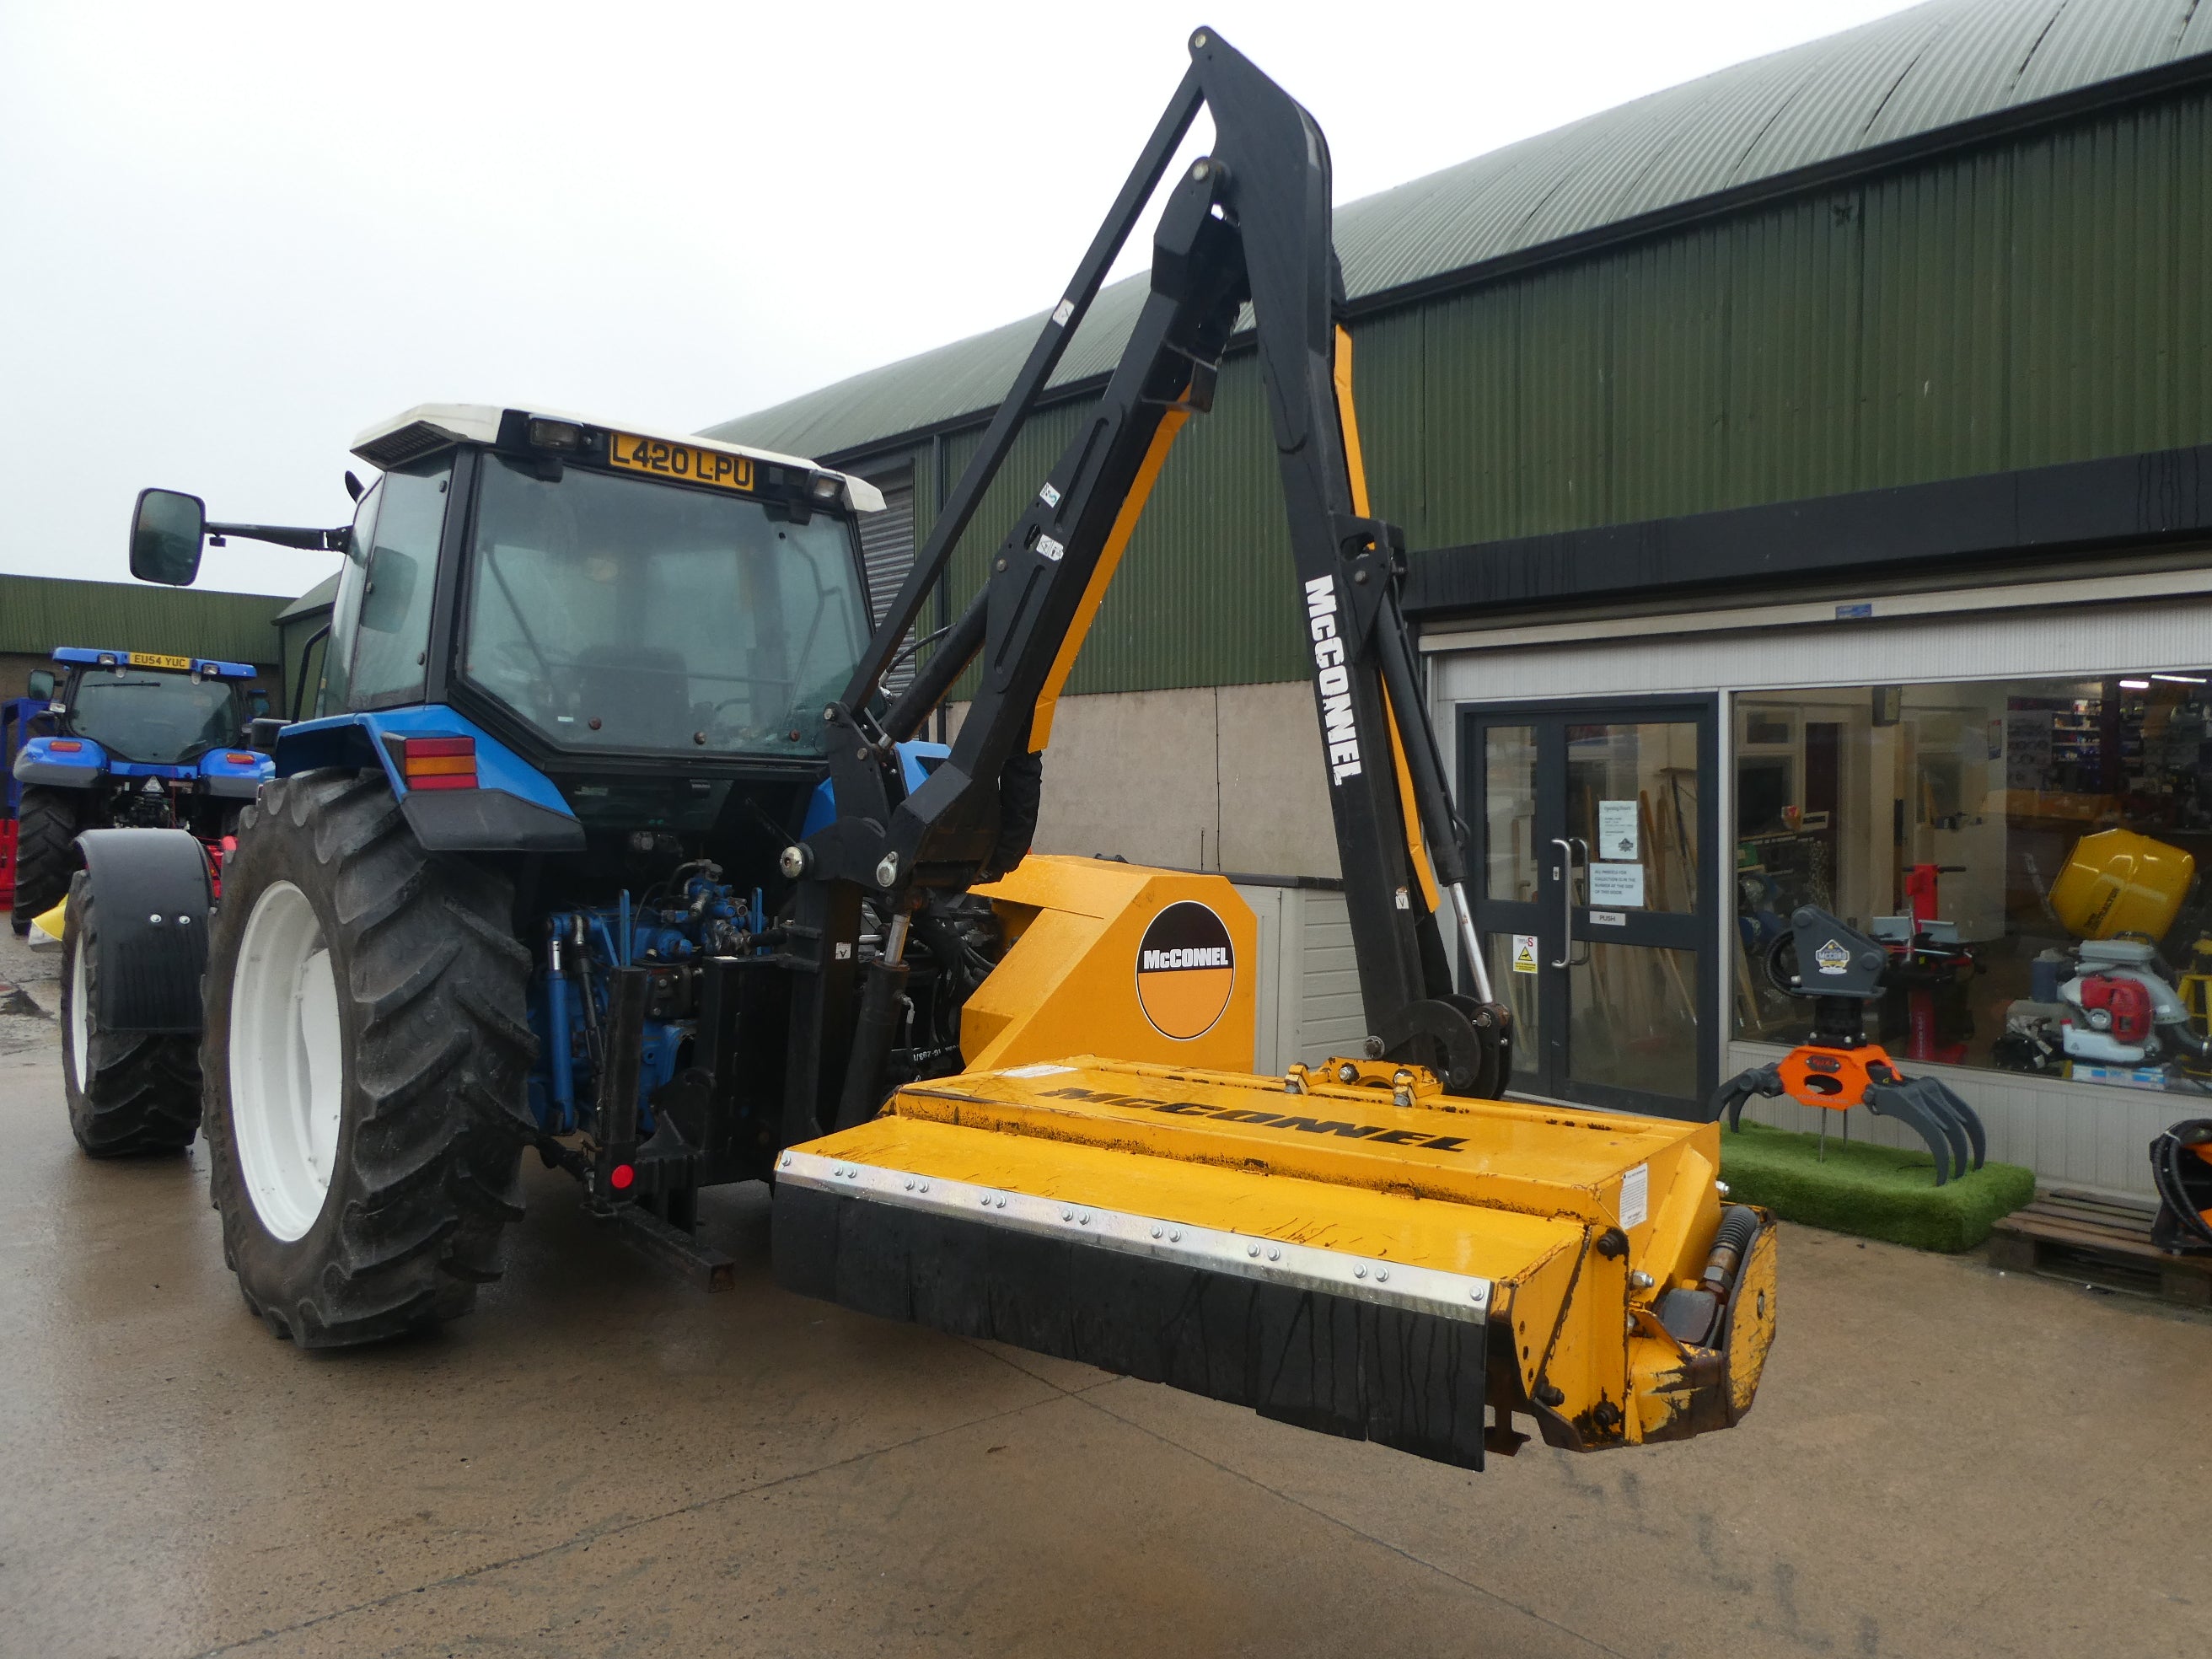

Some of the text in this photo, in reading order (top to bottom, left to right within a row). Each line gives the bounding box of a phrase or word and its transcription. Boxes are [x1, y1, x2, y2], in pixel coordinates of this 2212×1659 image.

[613, 434, 750, 486] L420 LPU
[134, 654, 185, 667] EU54 YUC
